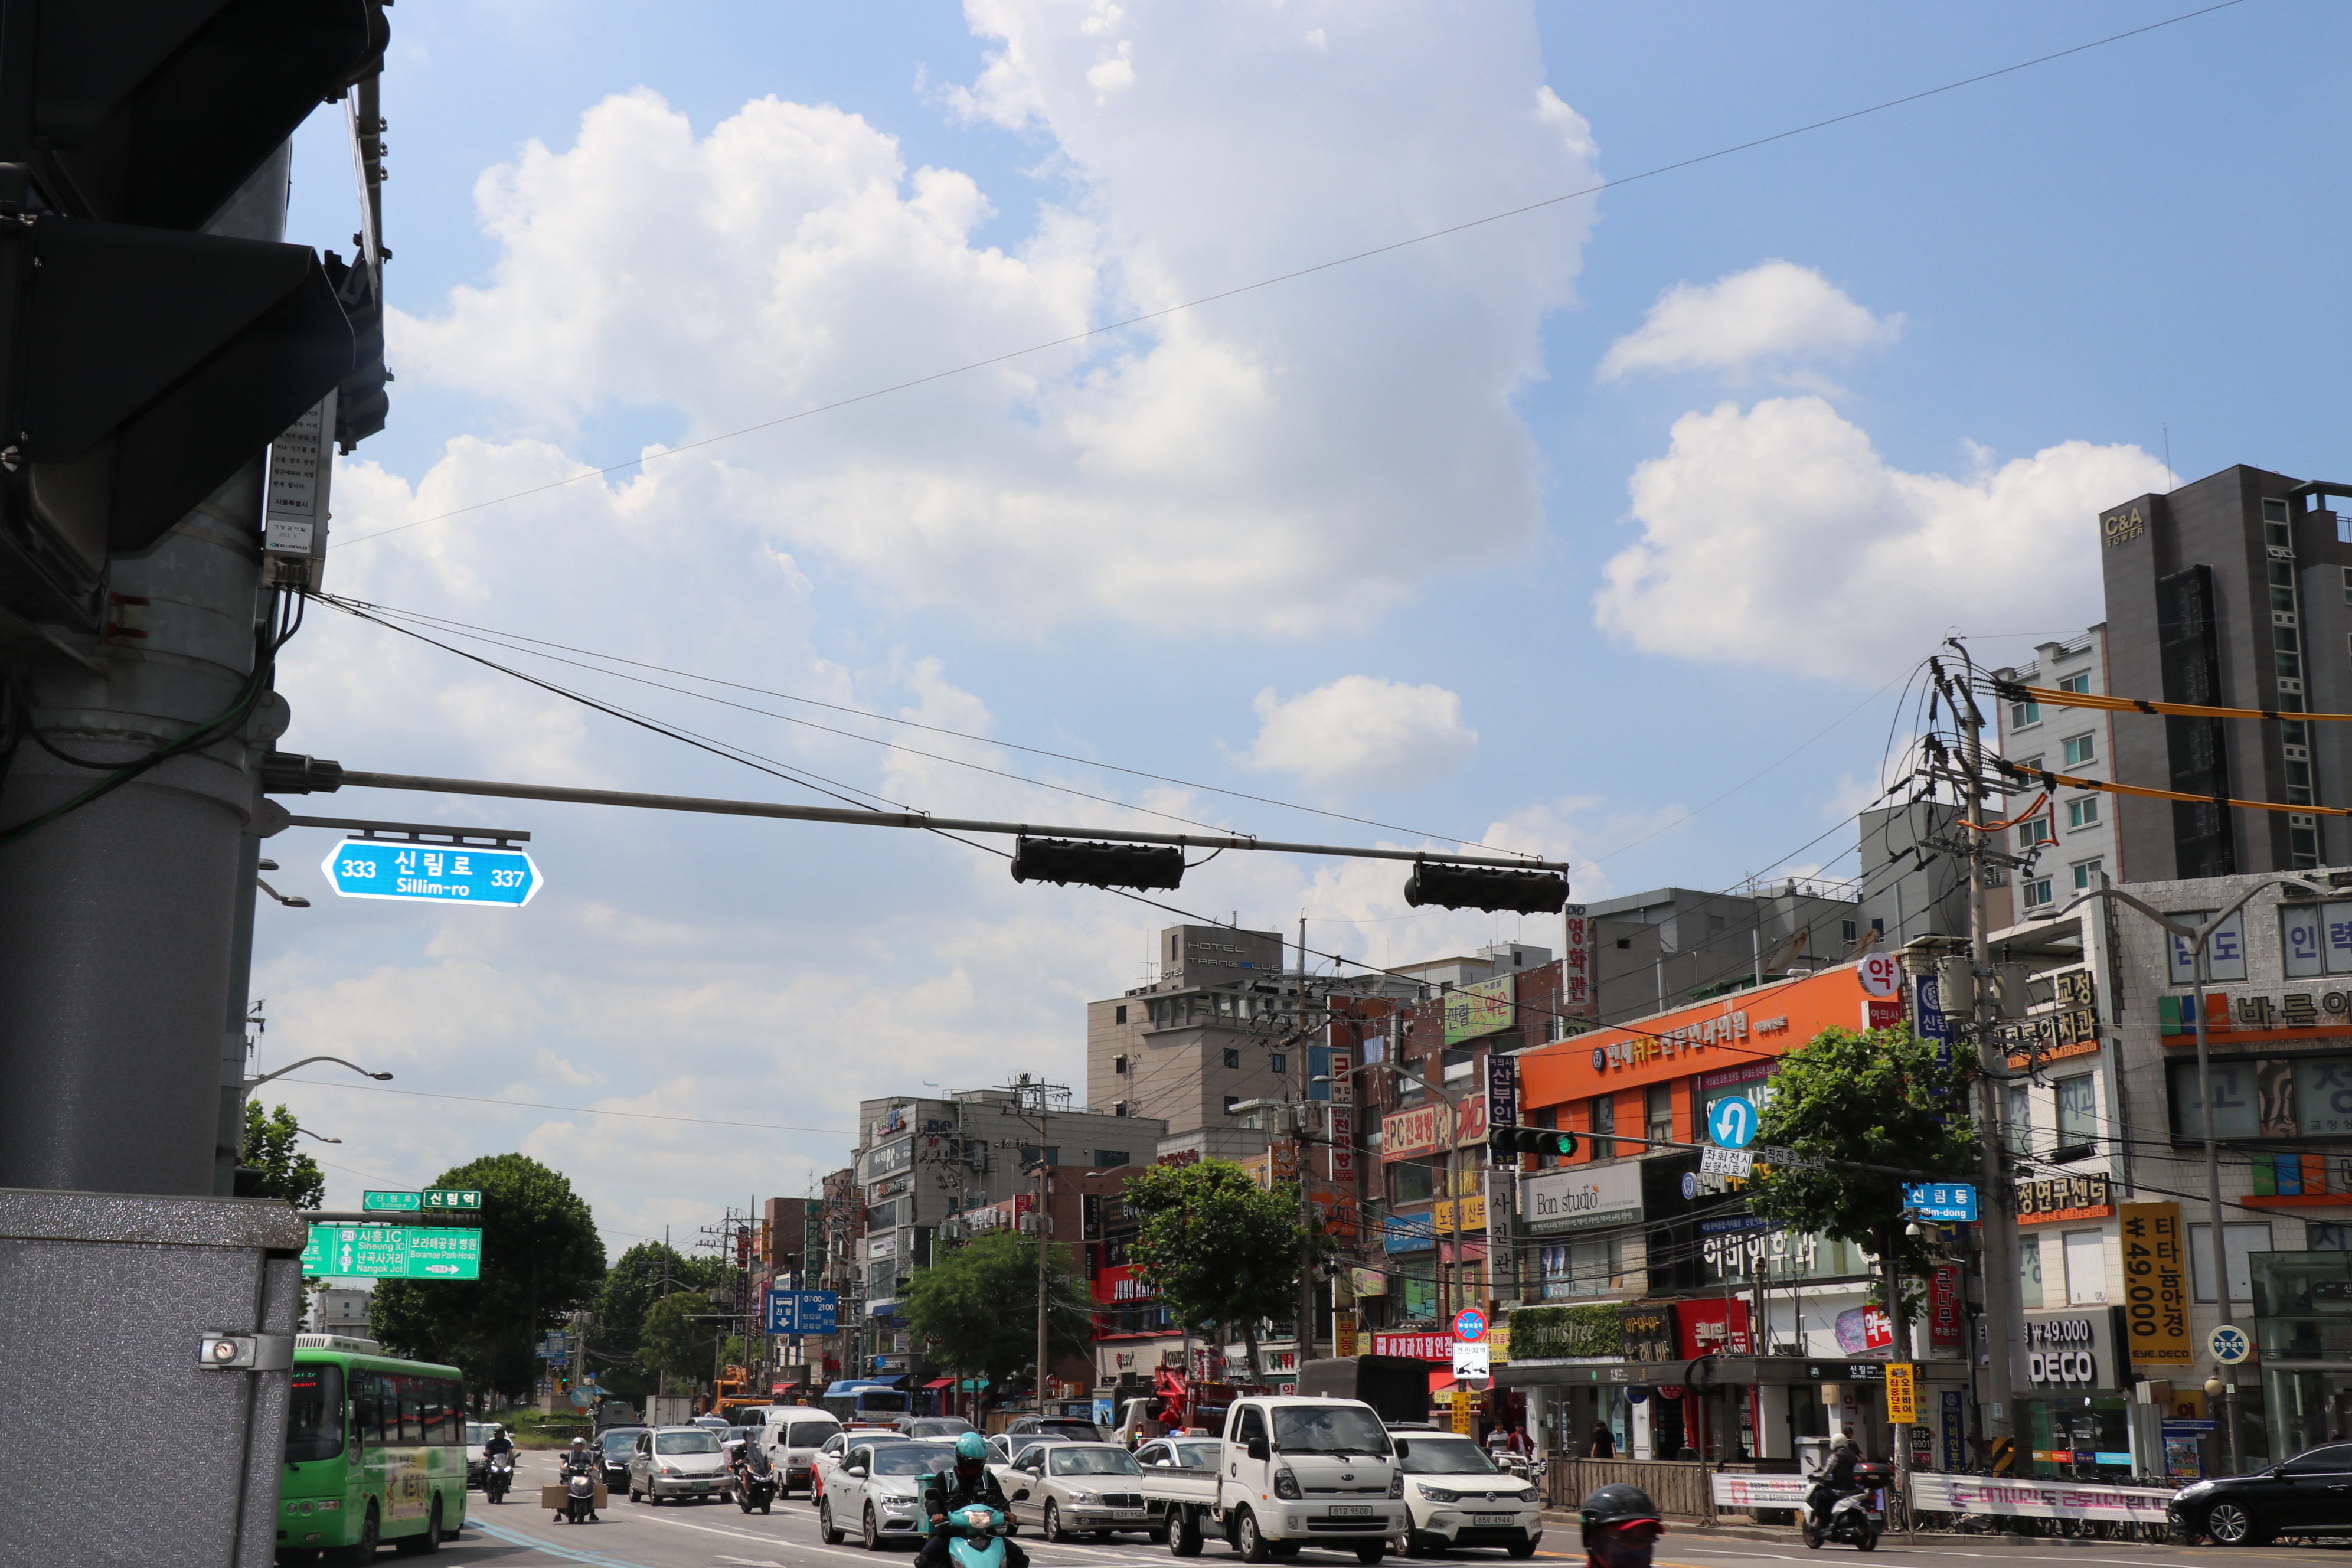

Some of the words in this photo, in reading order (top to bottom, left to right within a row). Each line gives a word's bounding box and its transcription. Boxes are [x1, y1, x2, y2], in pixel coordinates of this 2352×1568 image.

[275, 498, 308, 508] 서울특별시
[2106, 507, 2143, 535] C&A
[2106, 527, 2144, 548] TOWER
[341, 860, 377, 878] 333
[394, 851, 473, 877] 신림로
[491, 869, 525, 888] 337
[396, 878, 470, 897] Sillim-ro
[1188, 941, 1246, 953] HOTEL
[1188, 958, 1238, 968] TRANG
[1241, 962, 1280, 971] BLUE
[1567, 918, 1588, 1002] 영화관
[1161, 968, 1184, 979] HOTEL
[1868, 959, 1894, 990] 약
[2057, 972, 2095, 1005] 교정
[1485, 991, 1508, 1019] 약손
[1448, 1003, 1469, 1031] 신림
[1871, 1009, 1899, 1021] 여의사
[1489, 1057, 1513, 1067] 여의사
[1497, 1155, 1514, 1164] 3F
[1705, 1149, 1752, 1165] 좌회전시
[1703, 1161, 1749, 1177] 보행신호시
[375, 1194, 413, 1204] 신림로
[429, 1192, 475, 1206] 신림역
[1537, 1193, 1558, 1215] Bon
[1562, 1184, 1598, 1213] studio
[1912, 1188, 1968, 1204] 신림동
[2018, 1172, 2109, 1214] 정연구센터
[1920, 1208, 1966, 1219] illim-dong
[343, 1231, 353, 1240] 21
[1492, 1192, 1512, 1274] 사진관
[358, 1242, 394, 1253] Siheung
[396, 1243, 405, 1252] IC
[357, 1252, 404, 1265] 난곡사거리
[410, 1250, 441, 1259] Boramae
[357, 1265, 388, 1275] Nangok
[390, 1265, 404, 1274] Jct
[2155, 1216, 2184, 1337] 티타늄안경
[1114, 1279, 1134, 1301] JUNO
[1935, 1269, 1955, 1327] 큰나무
[776, 1308, 792, 1316] 전용
[1338, 1314, 1354, 1322] 열린
[1934, 1327, 1959, 1337] 부동산
[1456, 1347, 1487, 1355] 견인지역
[2213, 1341, 2244, 1350] 주정차금지
[2132, 1350, 2190, 1358] EYE.DECO
[1850, 1365, 1866, 1374] 신림
[1901, 1378, 1912, 1413] 오토바이
[1913, 1439, 1930, 1449] 8001
[1979, 1486, 2057, 1506] 대기시간도
[1350, 1507, 1370, 1516] 9508
[1493, 1515, 1511, 1524] 4944
